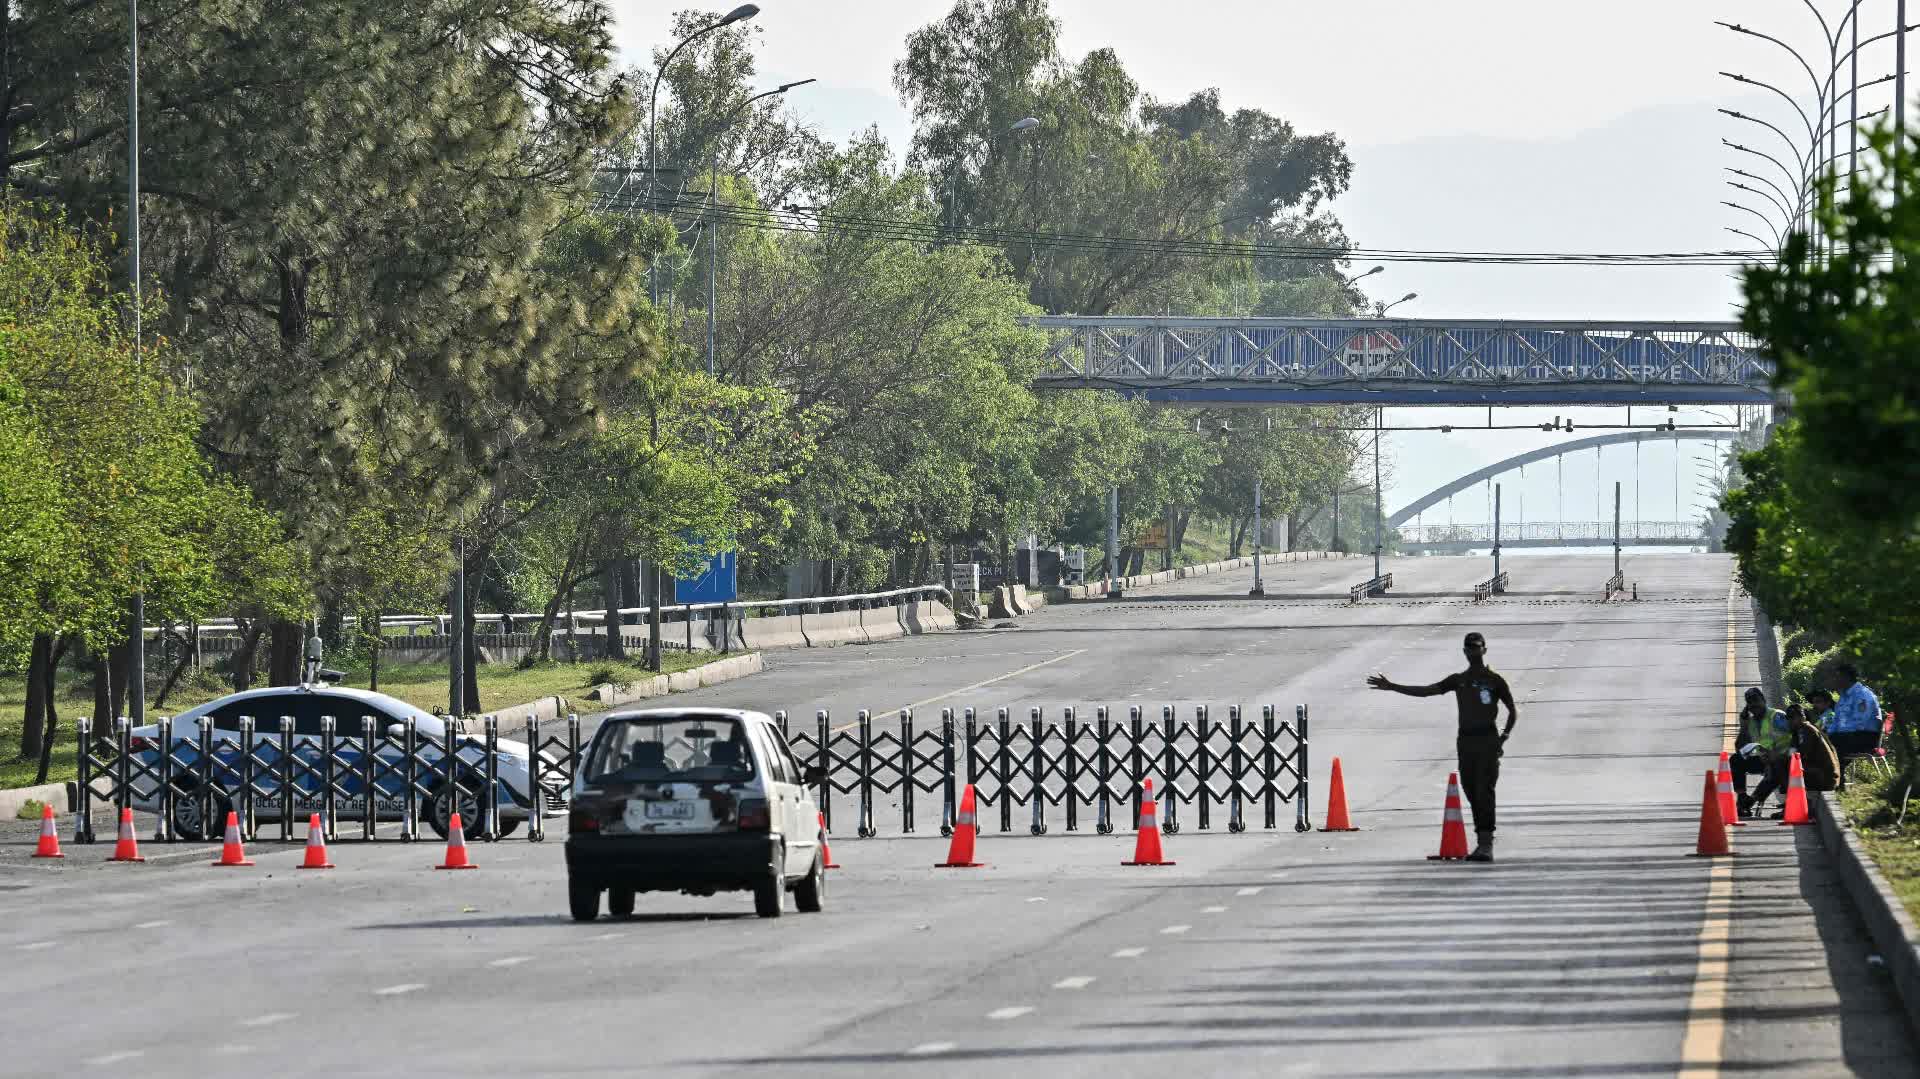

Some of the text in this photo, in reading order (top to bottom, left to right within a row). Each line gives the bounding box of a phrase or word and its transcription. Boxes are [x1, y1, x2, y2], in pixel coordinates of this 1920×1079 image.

[1613, 364, 1682, 380] SERVE
[254, 797, 405, 811] OLICE MERGCY REONSE
